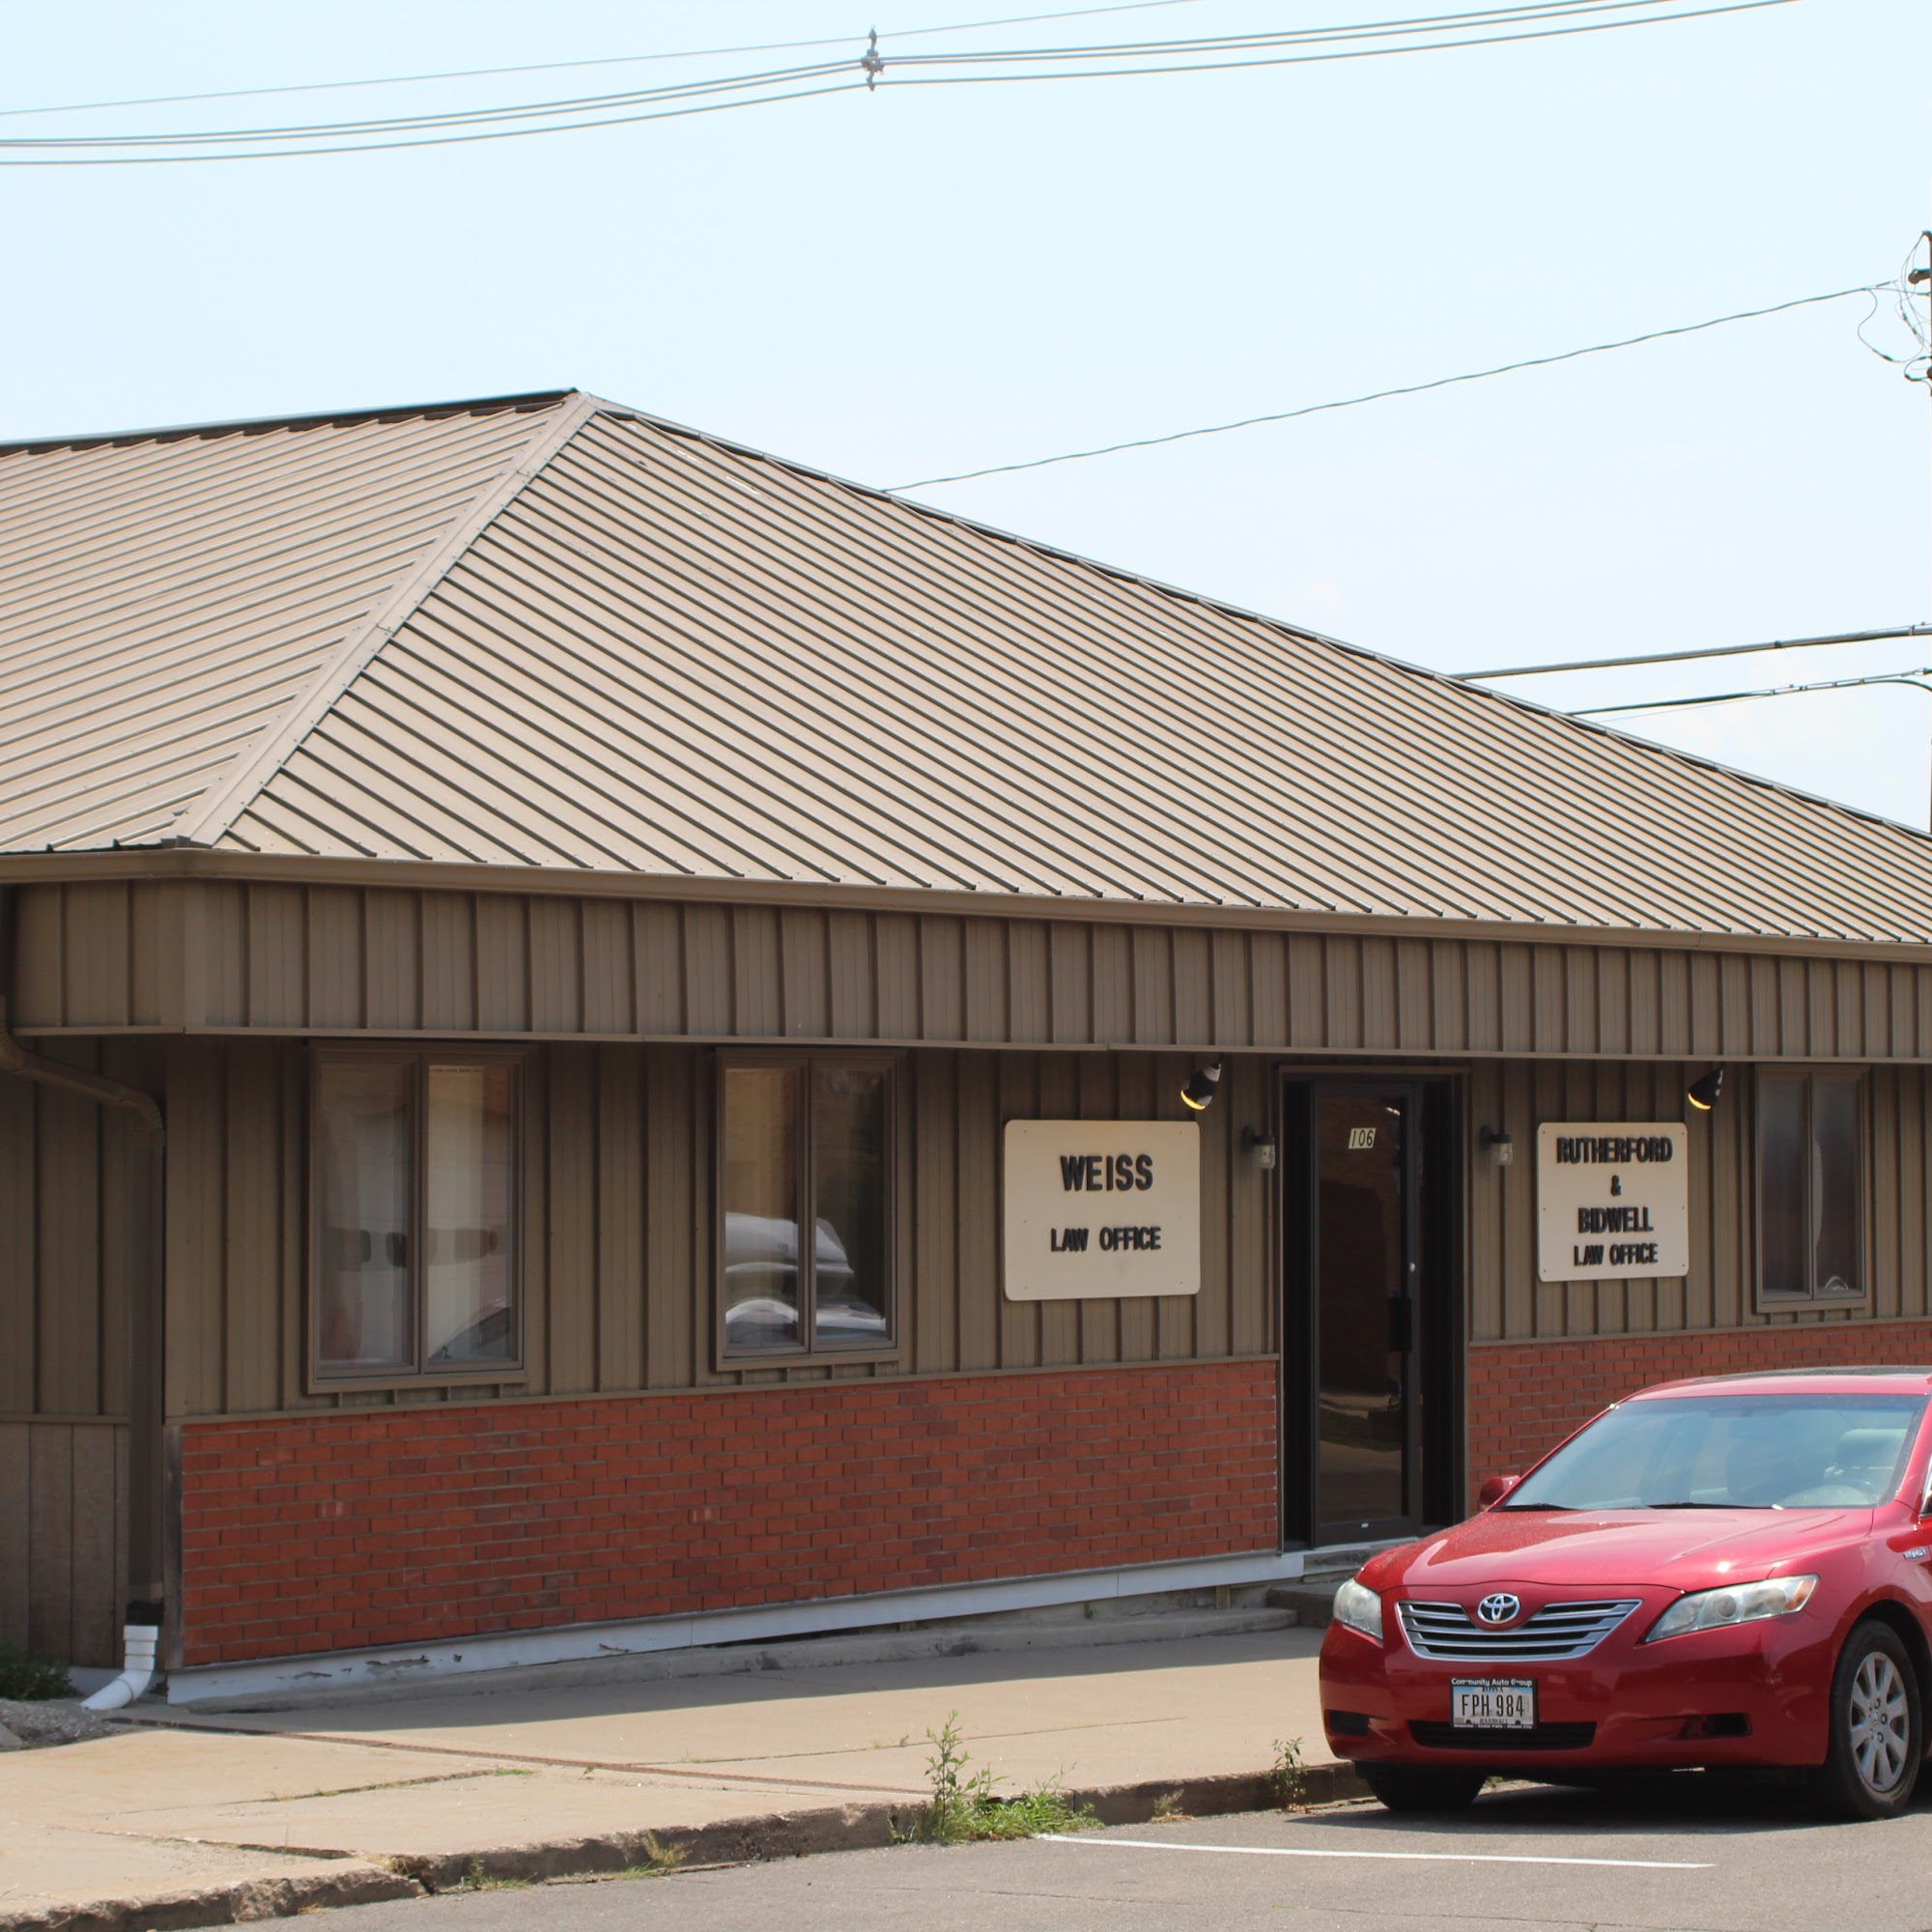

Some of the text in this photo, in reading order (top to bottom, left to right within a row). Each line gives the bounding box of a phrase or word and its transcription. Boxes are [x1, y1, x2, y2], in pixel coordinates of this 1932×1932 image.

[1351, 1129, 1374, 1147] 106
[1556, 1136, 1673, 1164] RUTHERFORD
[1060, 1153, 1153, 1191] WEISS
[1610, 1175, 1622, 1196] &
[1577, 1206, 1654, 1234] BIDWELL
[1050, 1226, 1161, 1252] LAW OFFICE
[1574, 1242, 1659, 1266] LAW OFFICE
[1451, 1678, 1490, 1687] Community
[1511, 1678, 1532, 1688] Group
[1462, 1694, 1524, 1717] FPH 984
